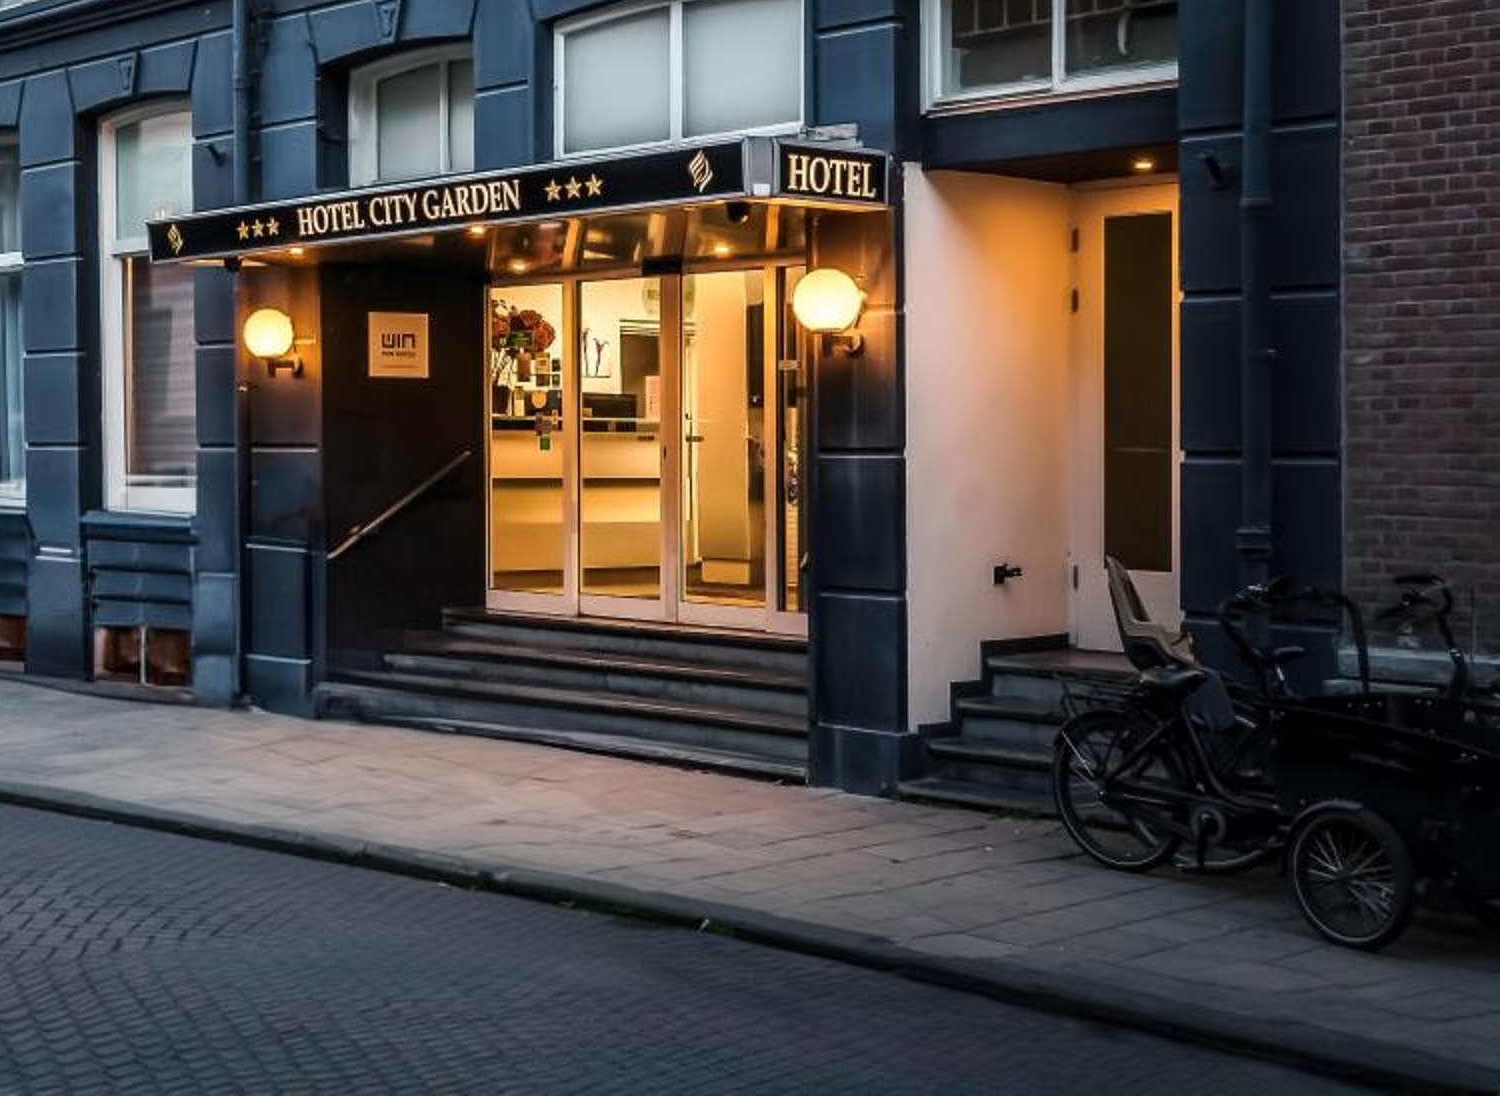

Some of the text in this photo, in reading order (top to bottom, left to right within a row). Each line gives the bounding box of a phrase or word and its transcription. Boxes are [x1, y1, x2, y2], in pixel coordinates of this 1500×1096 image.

[787, 154, 876, 199] HOTEL
[298, 179, 521, 236] HOTEL CITY GARDEN
